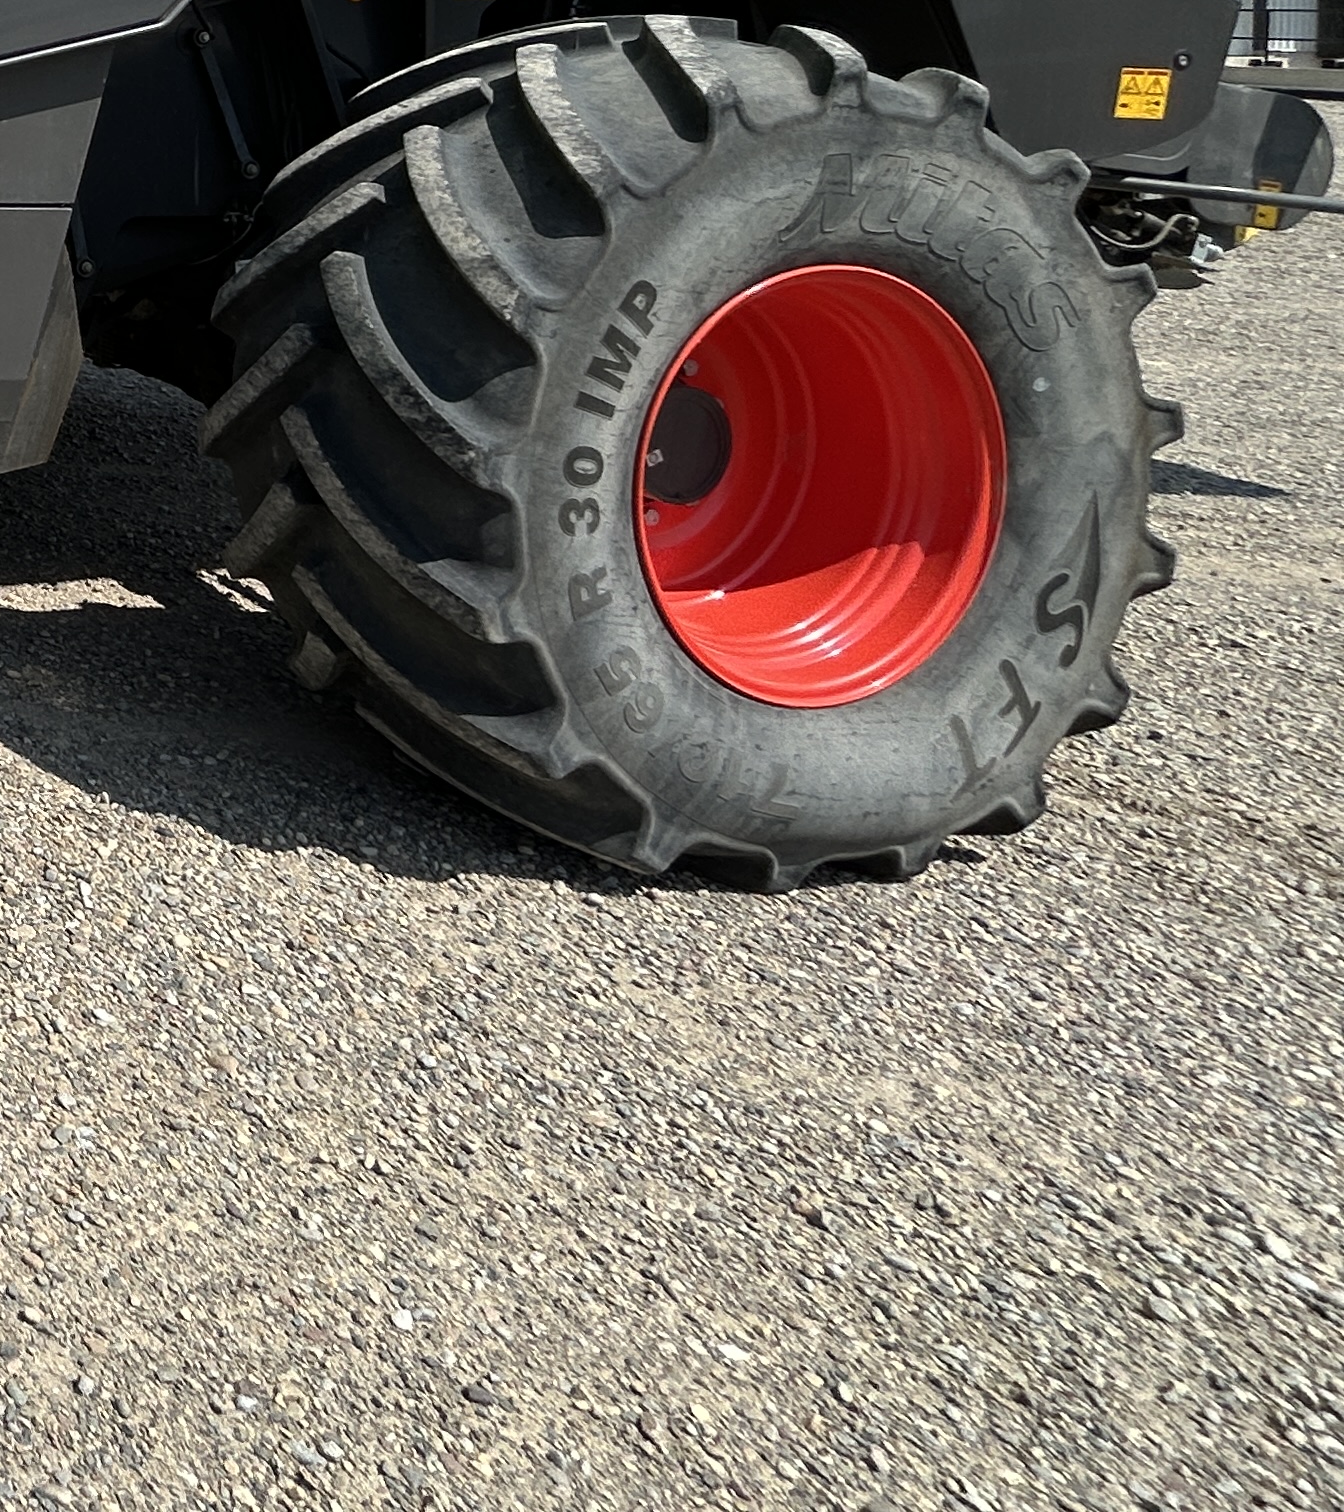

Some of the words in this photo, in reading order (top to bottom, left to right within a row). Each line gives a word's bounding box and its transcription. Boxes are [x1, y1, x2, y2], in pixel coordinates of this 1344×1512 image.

[572, 279, 658, 421] IMP
[557, 444, 605, 538] 30
[567, 563, 613, 622] R
